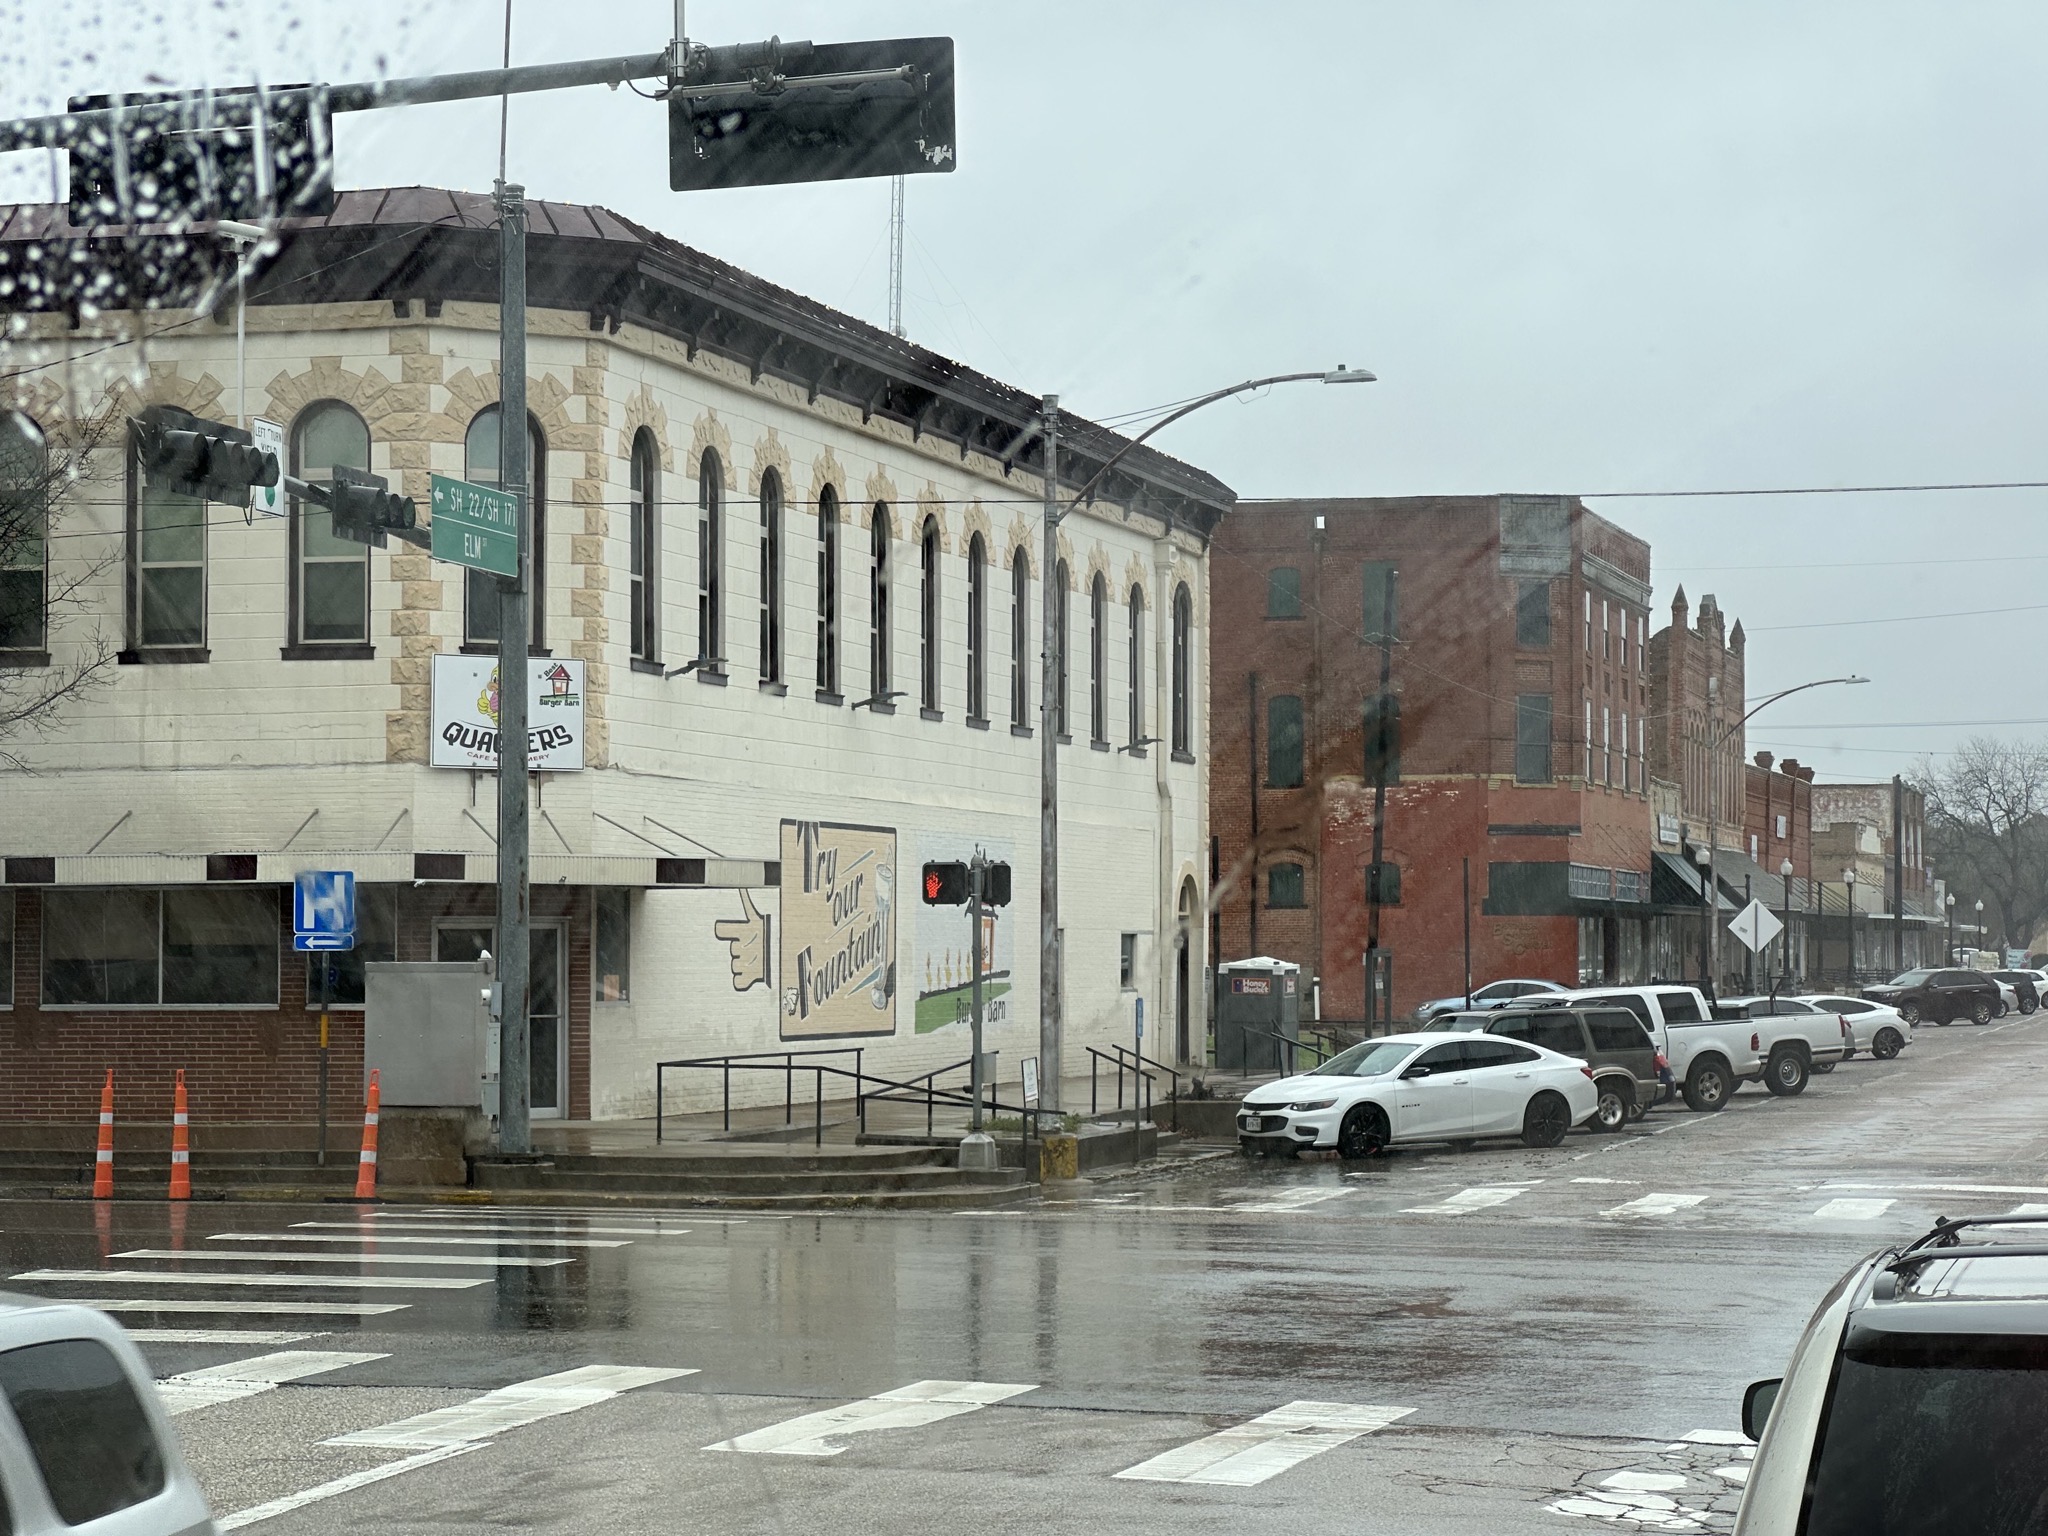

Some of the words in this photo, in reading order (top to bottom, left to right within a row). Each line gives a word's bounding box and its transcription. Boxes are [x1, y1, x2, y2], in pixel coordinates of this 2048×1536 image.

[255, 425, 266, 438] LEFT
[450, 487, 463, 513] SH
[468, 492, 499, 523] 22/SH
[504, 501, 516, 527] 171
[464, 532, 481, 560] ELM
[539, 699, 562, 708] Burger
[564, 699, 580, 707] Barn
[442, 721, 573, 753] QUAERS
[467, 751, 490, 761] CAFE
[796, 821, 838, 903] Try
[303, 874, 346, 931] H
[833, 872, 864, 927] our
[797, 913, 881, 1020] Fountain
[1243, 979, 1268, 988] Honey
[988, 997, 1006, 1022] Barn
